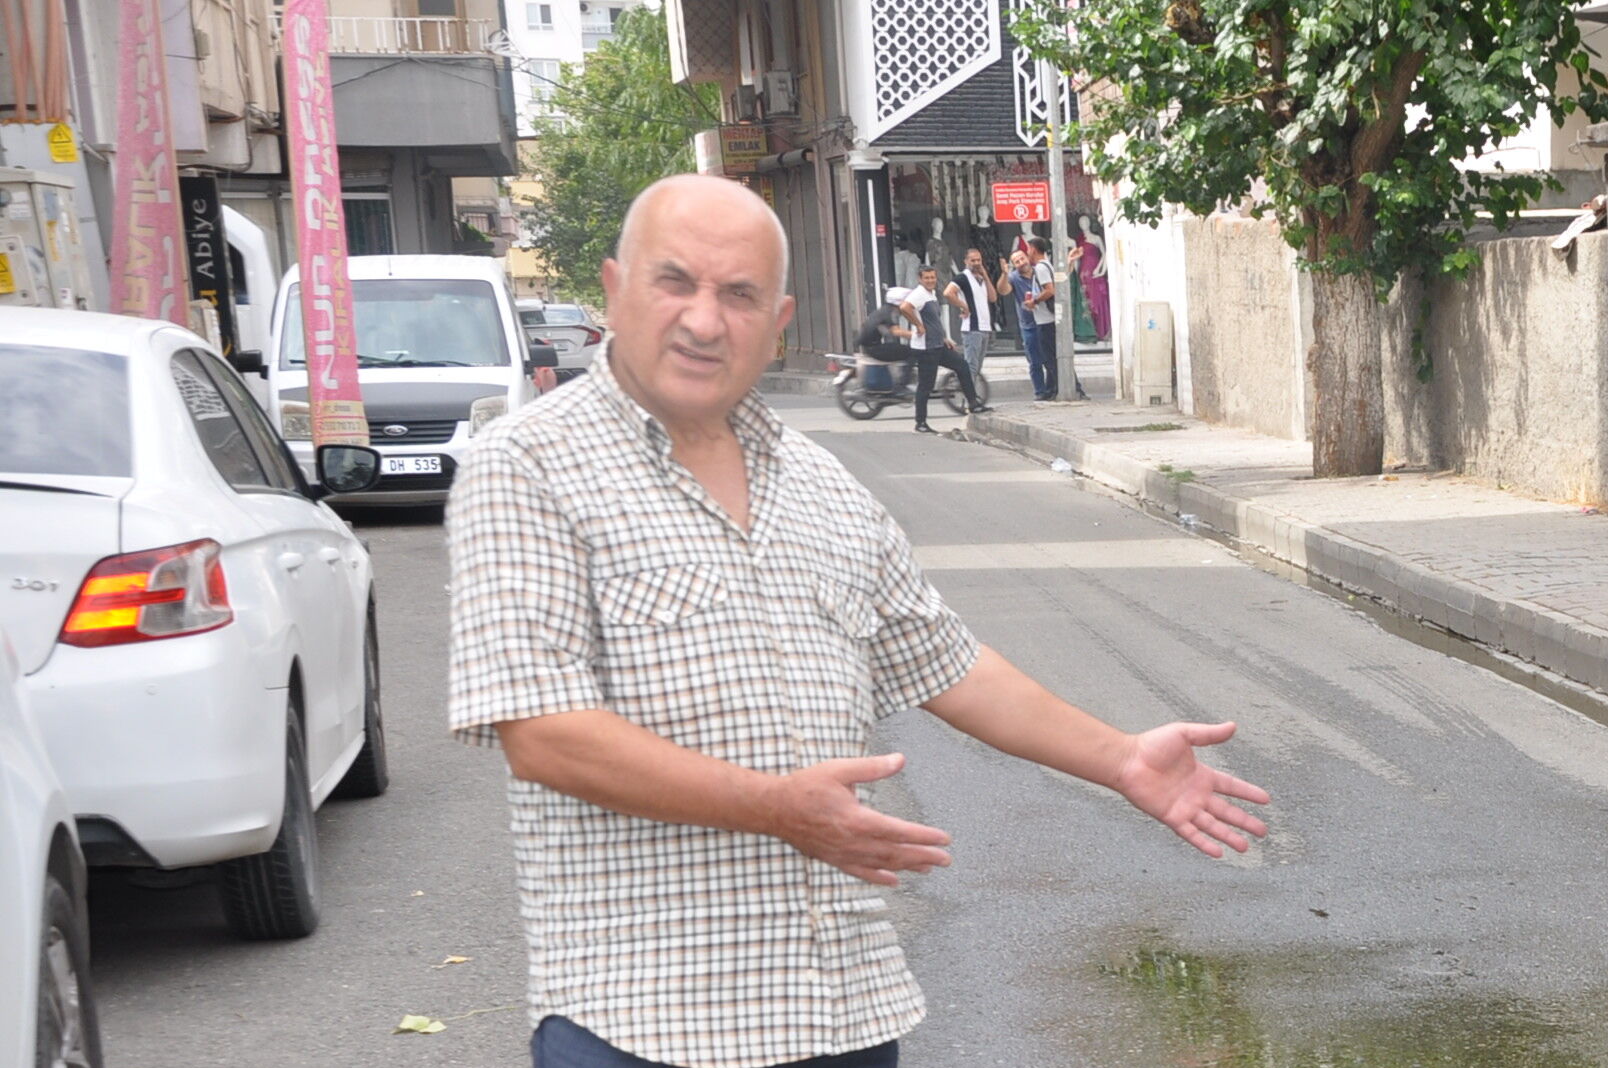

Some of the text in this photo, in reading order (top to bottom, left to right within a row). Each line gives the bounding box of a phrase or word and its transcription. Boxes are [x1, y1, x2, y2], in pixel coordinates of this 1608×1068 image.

[729, 141, 761, 152] EMLAK
[190, 198, 216, 279] Abiye
[390, 459, 438, 471] DH 535
